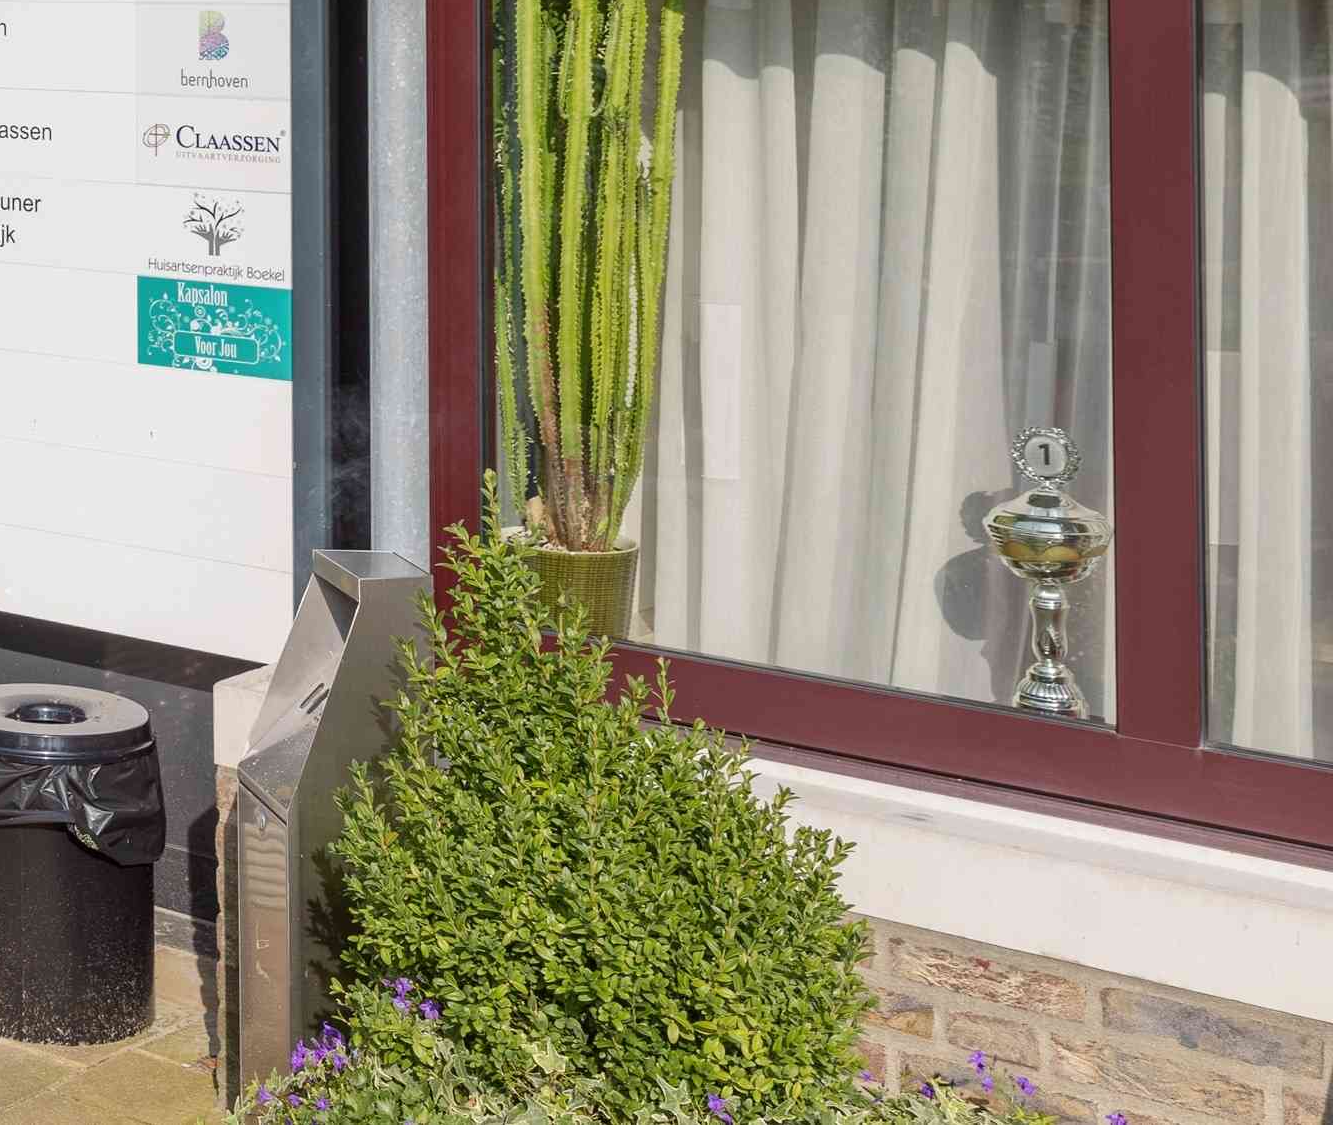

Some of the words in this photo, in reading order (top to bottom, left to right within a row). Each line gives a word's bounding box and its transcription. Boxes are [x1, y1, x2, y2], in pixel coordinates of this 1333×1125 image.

[180, 67, 249, 89] bernhoven
[175, 124, 281, 153] CLAASSEN
[148, 258, 244, 280] Huisartsenpraktijk
[246, 266, 285, 282] Boekel
[177, 281, 229, 307] Kapsalon
[194, 335, 217, 357] Voor
[219, 338, 237, 359] Jou
[1037, 443, 1051, 466] 1
